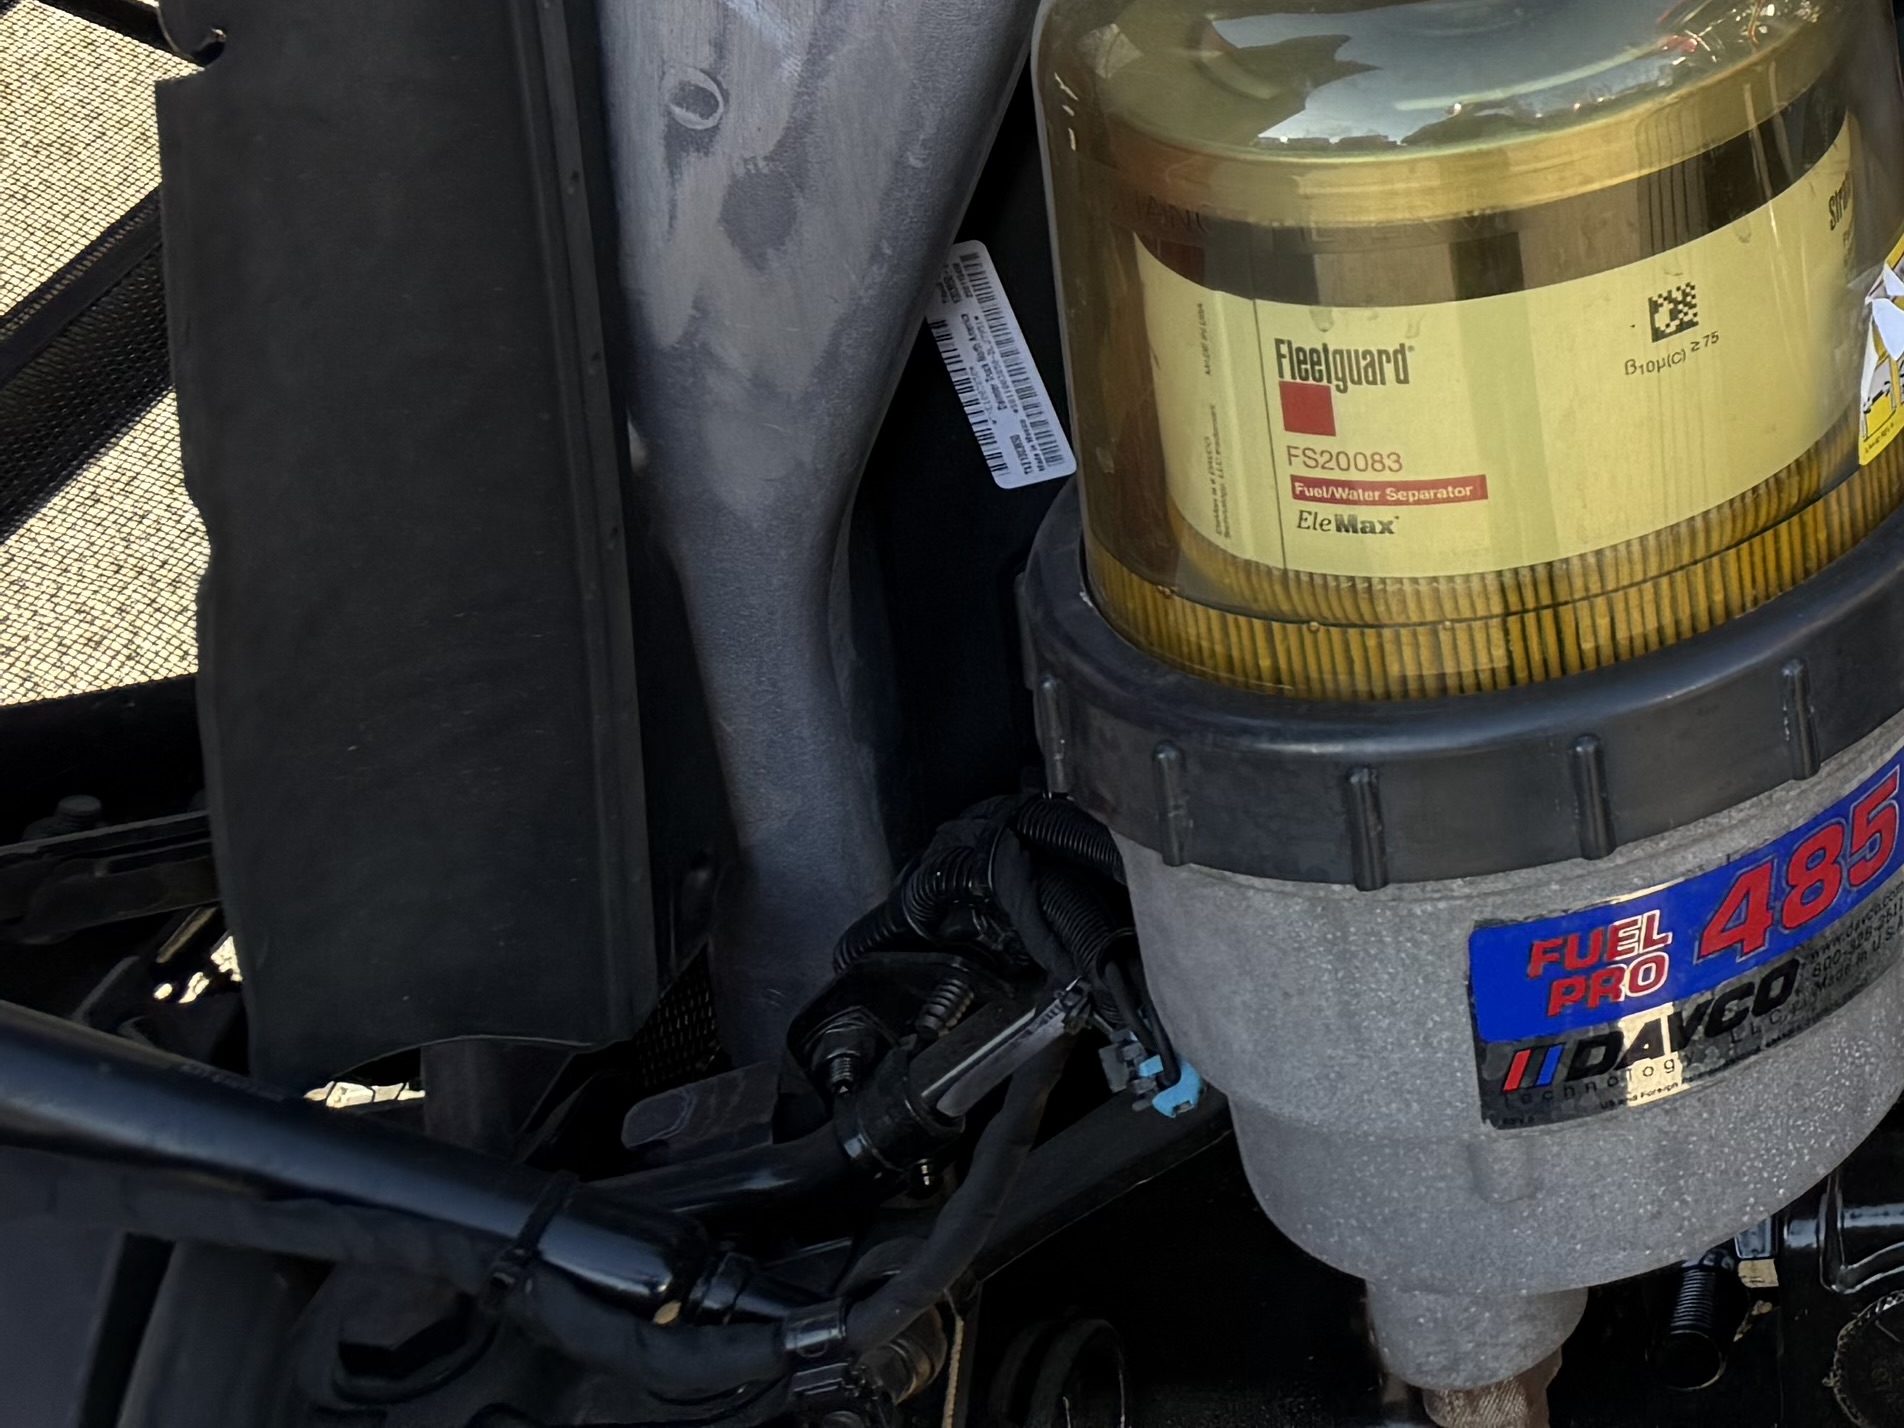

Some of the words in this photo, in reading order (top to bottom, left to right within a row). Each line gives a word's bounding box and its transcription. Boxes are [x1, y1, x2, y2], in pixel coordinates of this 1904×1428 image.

[1274, 337, 1412, 394] Fleetguard
[1286, 445, 1404, 473] FS20083
[1294, 482, 1381, 501] Fuel/Water
[1385, 482, 1474, 502] Separator
[1296, 510, 1397, 535] EleMax
[1697, 766, 1899, 963] 485
[1526, 909, 1673, 980] FUEL
[1546, 951, 1670, 1017] PRO
[1816, 968, 1852, 992] Made
[1563, 957, 1802, 1082] DAVCO
